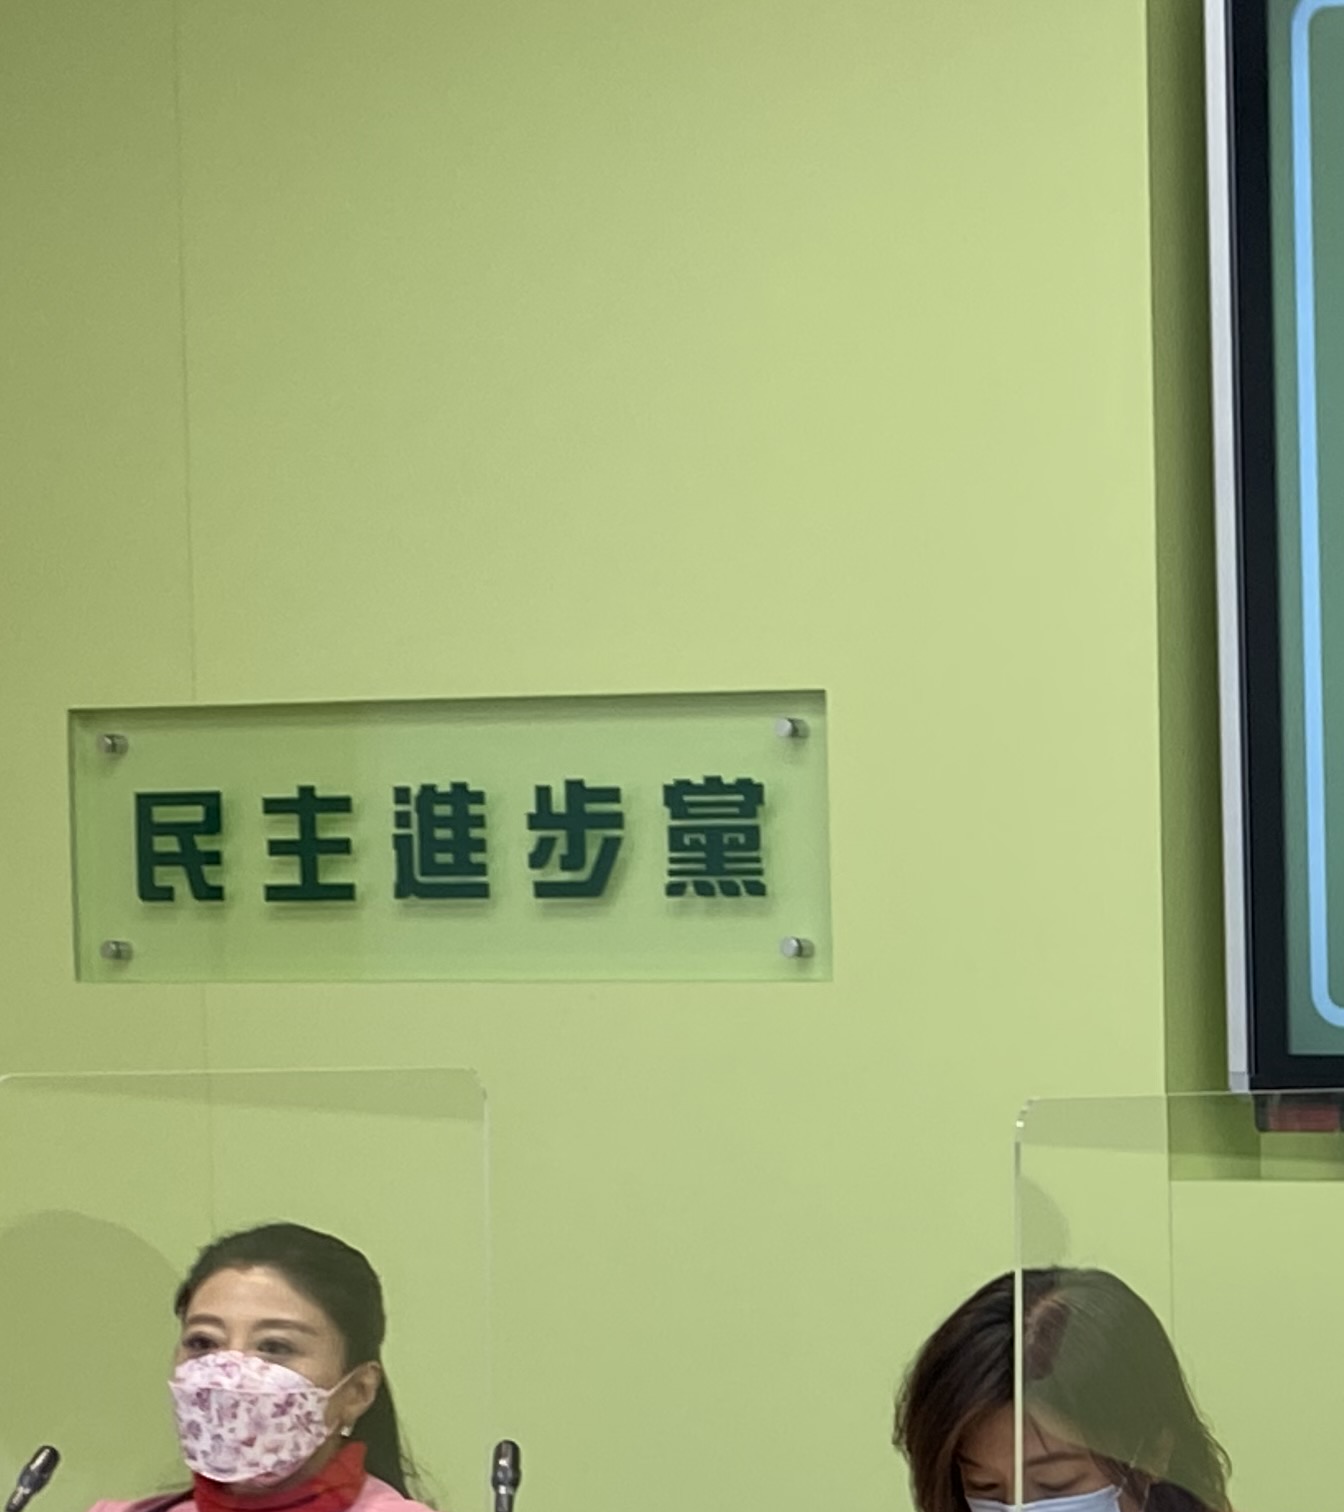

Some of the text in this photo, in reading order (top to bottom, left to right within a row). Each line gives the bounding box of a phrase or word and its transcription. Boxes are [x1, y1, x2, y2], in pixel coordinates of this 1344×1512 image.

[134, 775, 768, 902] 民主進步黨
